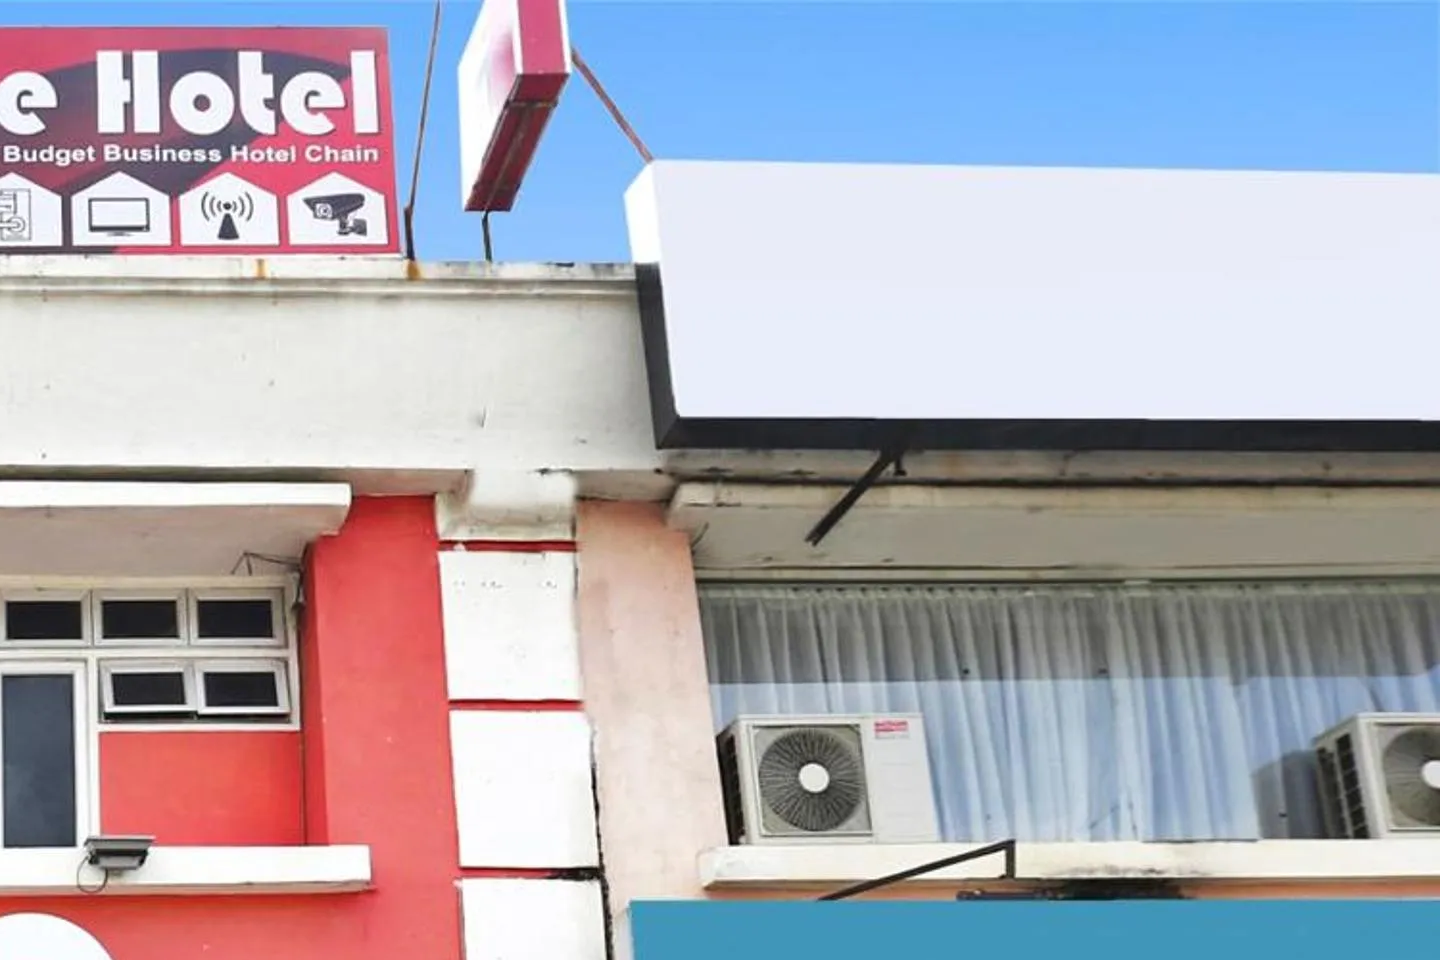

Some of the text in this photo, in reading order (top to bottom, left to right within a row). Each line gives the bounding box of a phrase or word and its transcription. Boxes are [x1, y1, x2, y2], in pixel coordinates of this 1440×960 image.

[96, 50, 379, 135] Hotel
[3, 144, 96, 168] Budget
[103, 143, 222, 163] Business
[230, 144, 297, 163] Hotel
[304, 144, 379, 163] Chain
